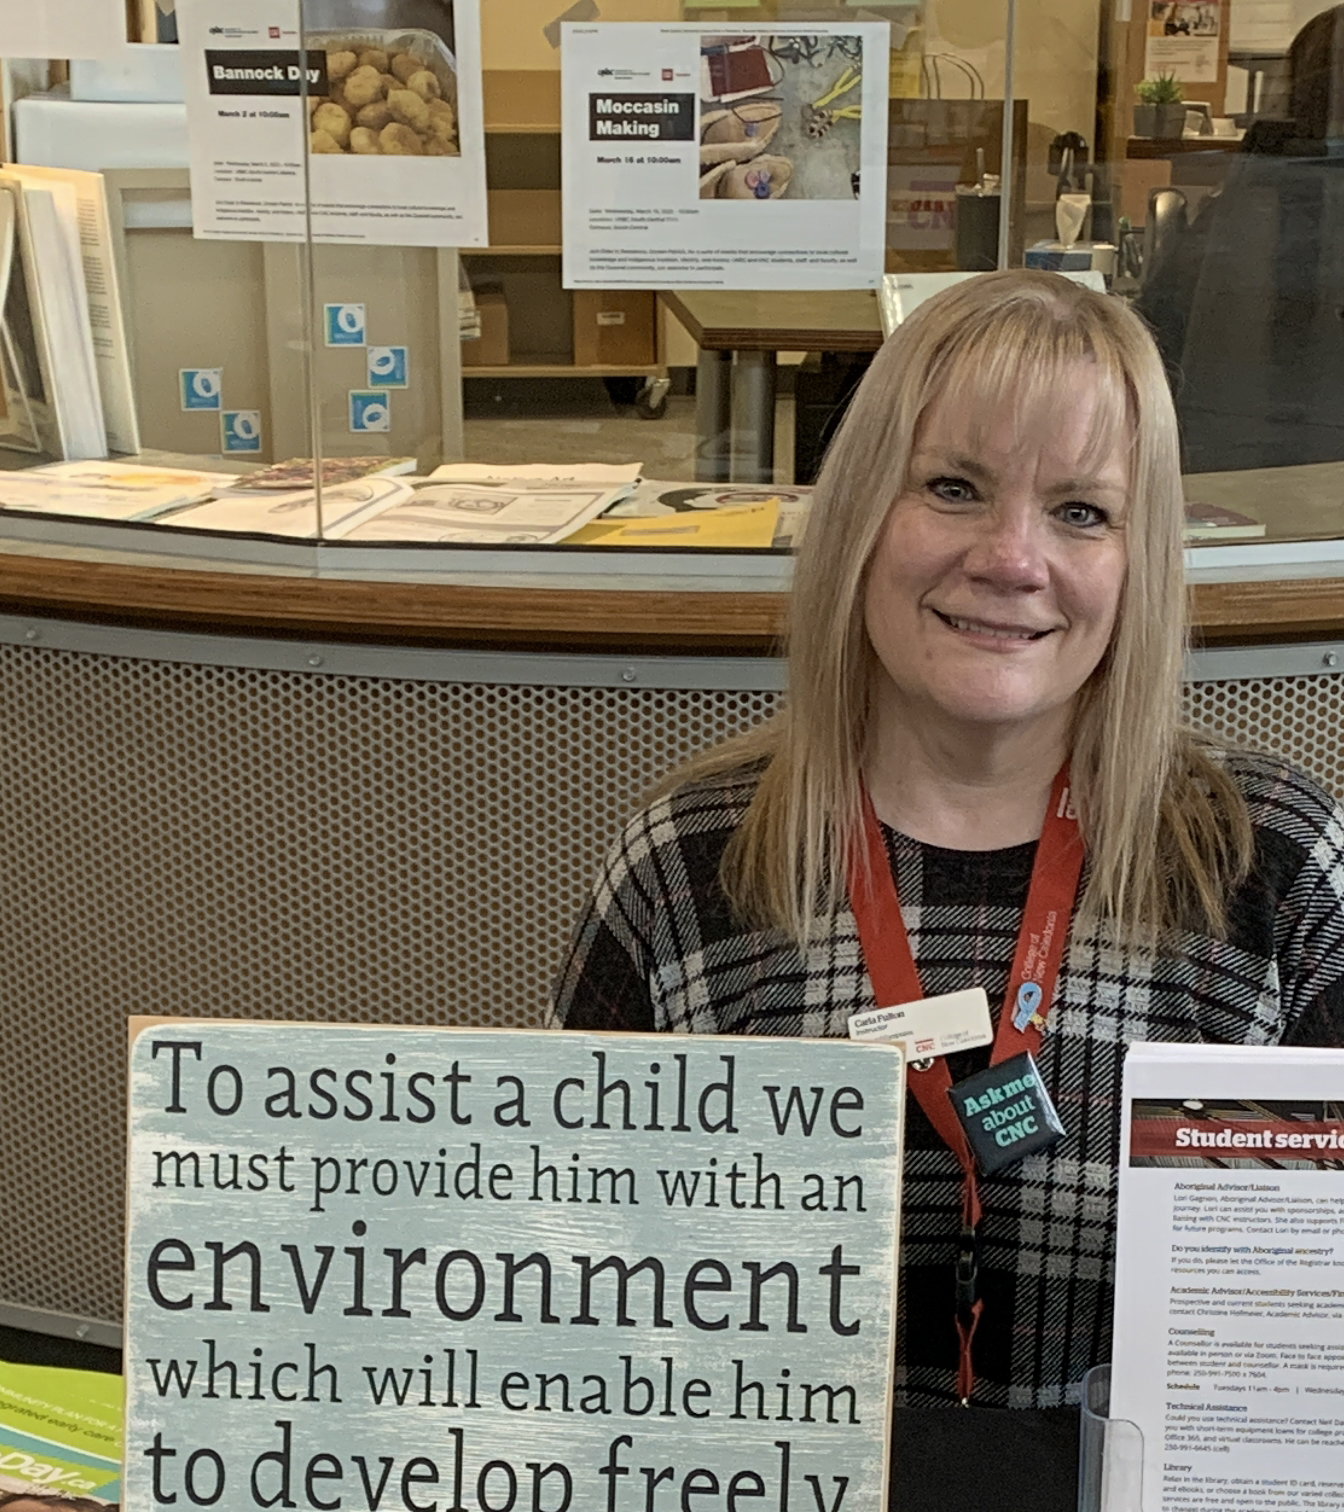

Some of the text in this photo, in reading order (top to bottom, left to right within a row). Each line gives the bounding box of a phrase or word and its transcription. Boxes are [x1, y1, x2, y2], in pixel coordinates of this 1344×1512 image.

[214, 66, 283, 80] Bannock
[596, 100, 679, 114] Moccasin
[596, 121, 660, 138] Making
[854, 1017, 877, 1028] Carla
[152, 1041, 864, 1138] To assist a child we
[964, 1075, 1035, 1117] Ask me
[982, 1095, 1035, 1131] about
[996, 1116, 1038, 1147] CNC
[1176, 1127, 1274, 1149] Student
[152, 1144, 866, 1212] must provide him with an
[147, 1220, 861, 1338] environment
[146, 1339, 860, 1424] which will enable him
[144, 1427, 225, 1504] to
